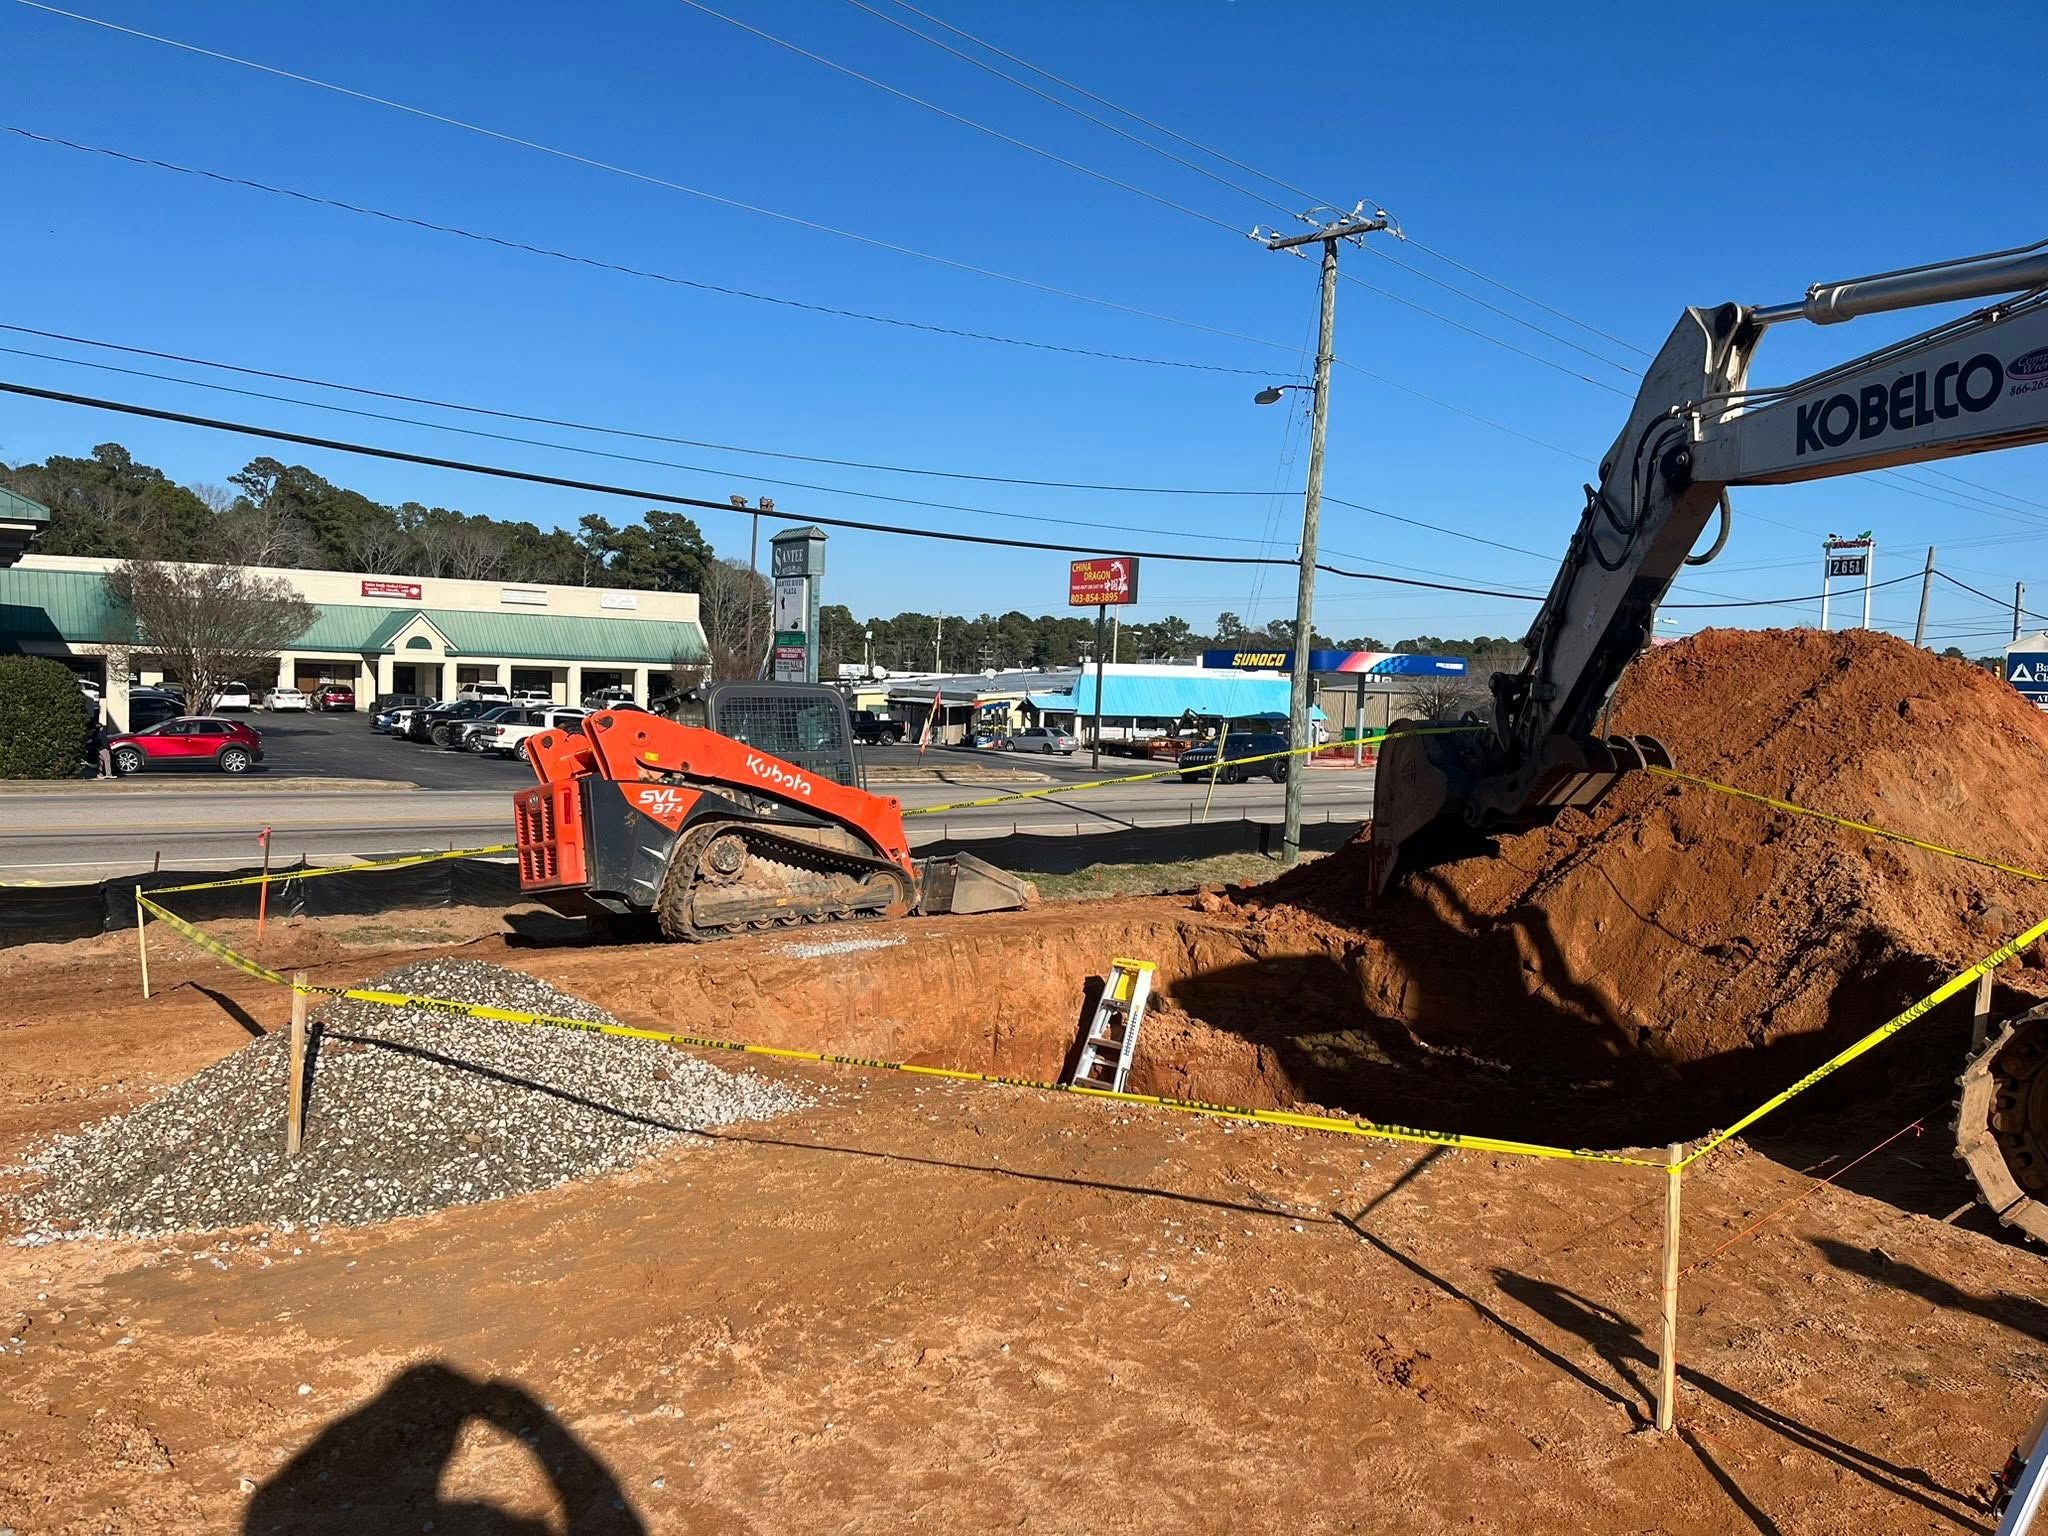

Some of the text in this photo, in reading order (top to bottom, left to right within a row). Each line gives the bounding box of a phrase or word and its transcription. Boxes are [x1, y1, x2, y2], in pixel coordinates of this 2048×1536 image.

[1796, 353, 2004, 456] KOBELCO
[774, 547, 804, 575] SANTEE
[1072, 562, 1091, 573] CHINA
[1083, 570, 1111, 581] DRAGON
[1071, 592, 1119, 603] 803-854-3895
[1232, 653, 1287, 667] SUNOCO
[746, 754, 812, 796] Kubota
[638, 788, 683, 804] SVL
[652, 803, 683, 815] 97-2
